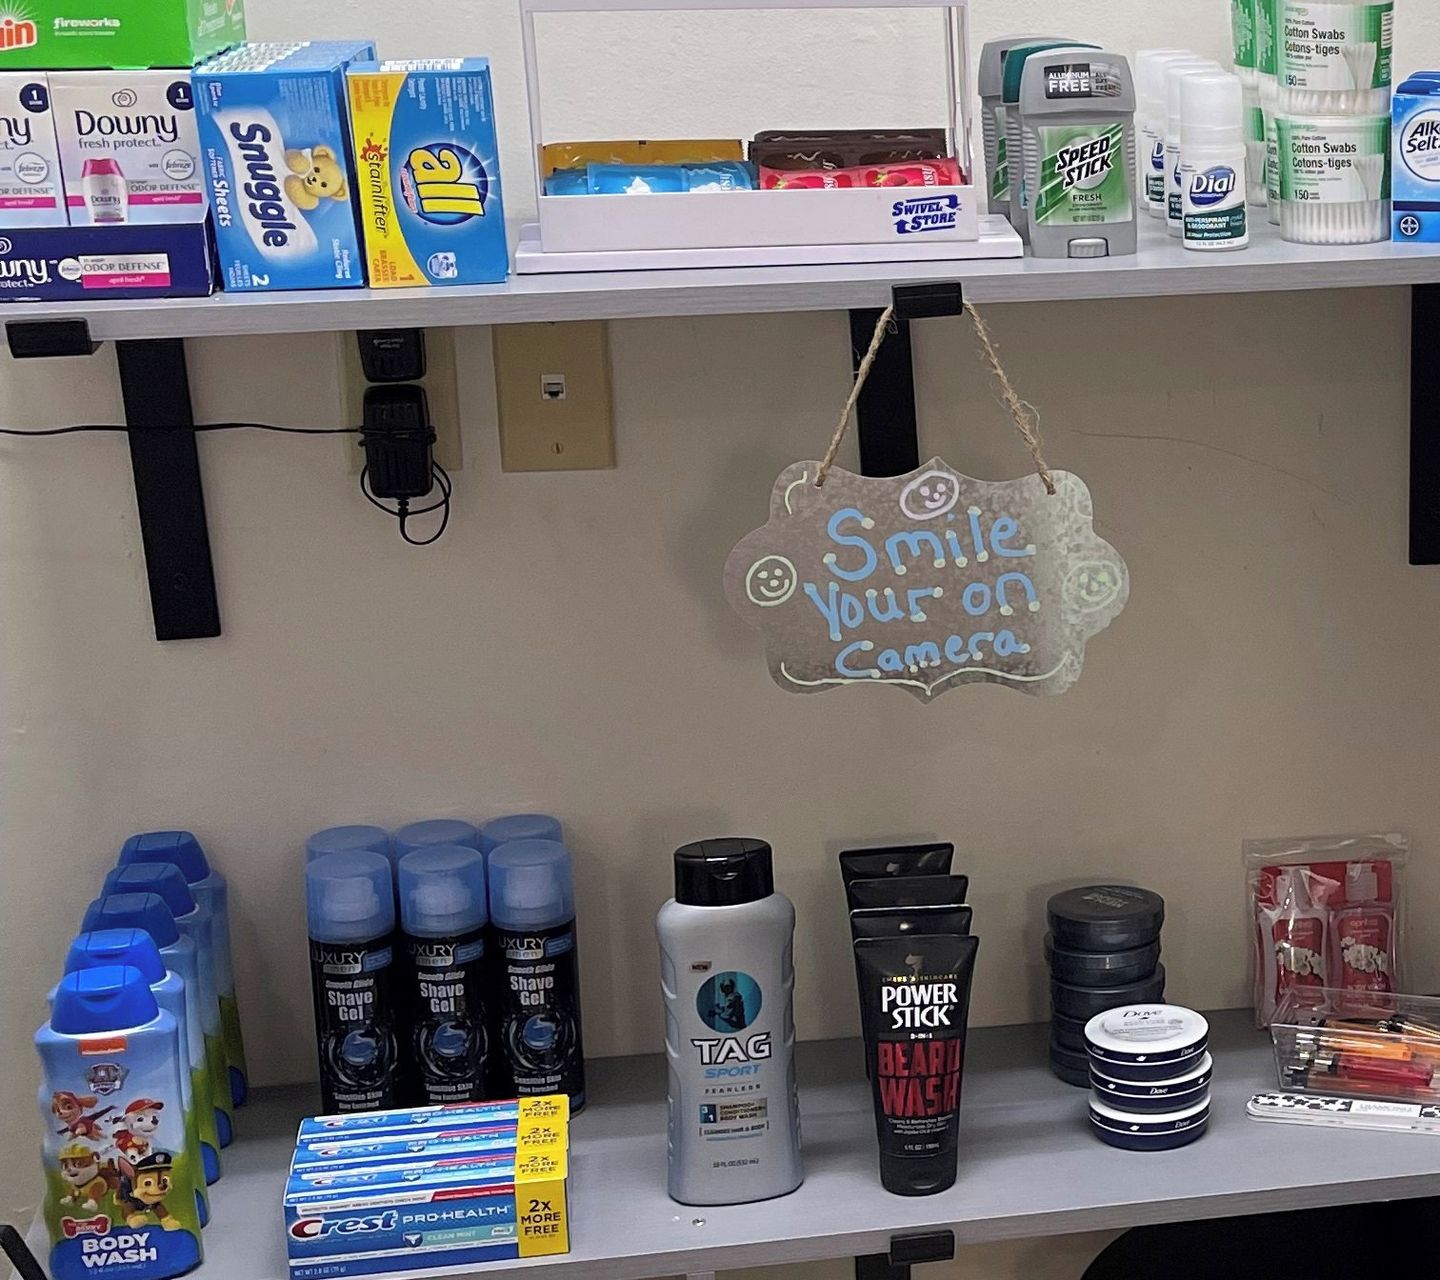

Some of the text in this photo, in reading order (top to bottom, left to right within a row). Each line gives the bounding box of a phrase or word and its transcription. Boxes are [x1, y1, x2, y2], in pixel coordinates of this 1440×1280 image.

[54, 18, 120, 29] fireworks
[1285, 25, 1345, 40] Cotton Swabs
[1285, 43, 1340, 56] Cotons-tiges
[1049, 71, 1090, 80] ALUMINUM
[1049, 80, 1090, 93] FREE
[75, 110, 179, 143] Downy
[79, 138, 110, 149] fresh
[1292, 142, 1357, 154] Cotton Swabs
[1056, 135, 1112, 171] SPEED
[1293, 157, 1352, 168] Cotons-tiges
[1063, 153, 1113, 190] STICK
[230, 122, 296, 247] Snuggle
[409, 148, 485, 216] all
[1191, 173, 1235, 193] Dial
[367, 151, 387, 237] stainlifter
[1073, 193, 1102, 202] FRESH
[1294, 189, 1308, 200] 150
[213, 180, 231, 227] Sheets
[892, 200, 943, 217] SWIVEL
[911, 211, 957, 229] STORE
[84, 263, 115, 271] ODOR
[252, 274, 269, 286] 2
[823, 506, 1036, 581] Smile
[962, 572, 1041, 616] on
[834, 628, 1031, 679] Camera
[420, 983, 464, 997] Shave
[511, 976, 553, 990] Shave
[328, 991, 373, 1006] Shave
[520, 990, 545, 1005] Gel
[882, 983, 958, 1012] POWER
[339, 1006, 364, 1020] Gel
[430, 998, 455, 1013] Gel
[892, 1005, 950, 1029] STICK
[1123, 1009, 1163, 1018] Dove
[691, 1032, 771, 1065] TAG
[878, 1039, 960, 1077] BEARD
[704, 1065, 760, 1078] SPORT
[705, 1084, 760, 1094] FEARLESS
[880, 1071, 959, 1117] WASH
[1150, 1087, 1169, 1095] Dove
[1175, 1120, 1190, 1128] Dove
[290, 1210, 397, 1240] Crest
[521, 1213, 561, 1224] MORE
[524, 1224, 559, 1235] FREE
[82, 1232, 150, 1253] BODY
[81, 1247, 157, 1268] WASH
